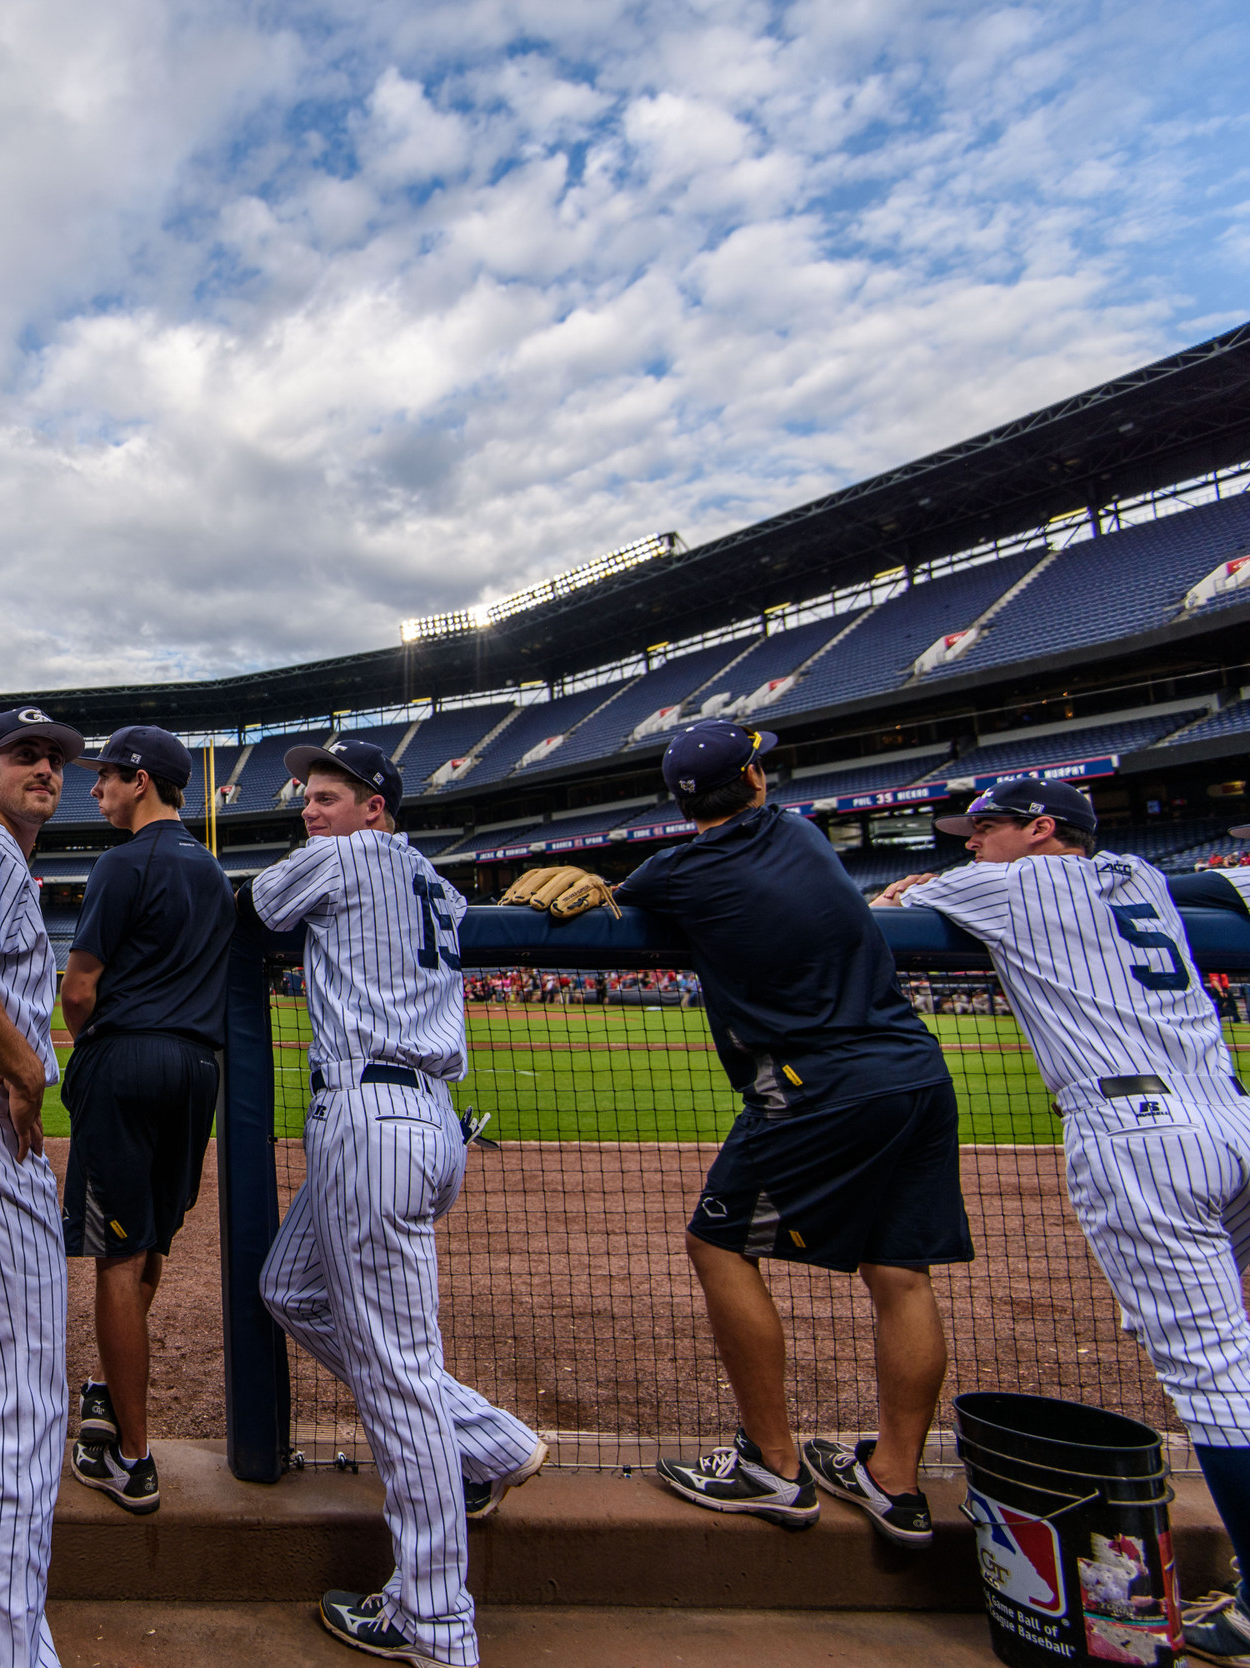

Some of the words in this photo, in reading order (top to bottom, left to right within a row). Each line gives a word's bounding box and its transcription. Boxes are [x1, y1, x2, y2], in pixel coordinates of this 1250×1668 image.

[1044, 765, 1086, 779] MURPHY
[853, 797, 872, 807] PHIL
[876, 793, 893, 804] 35
[897, 788, 929, 800] NIEKRO
[634, 827, 650, 838] EDDIE
[479, 851, 494, 860] JACKIE
[496, 849, 504, 858] 42
[1102, 862, 1132, 873] ACC
[1110, 903, 1190, 991] 5
[980, 1547, 1011, 1586] GT
[991, 1594, 1015, 1618] Game
[1017, 1610, 1041, 1632] Ball
[1043, 1625, 1059, 1638] of
